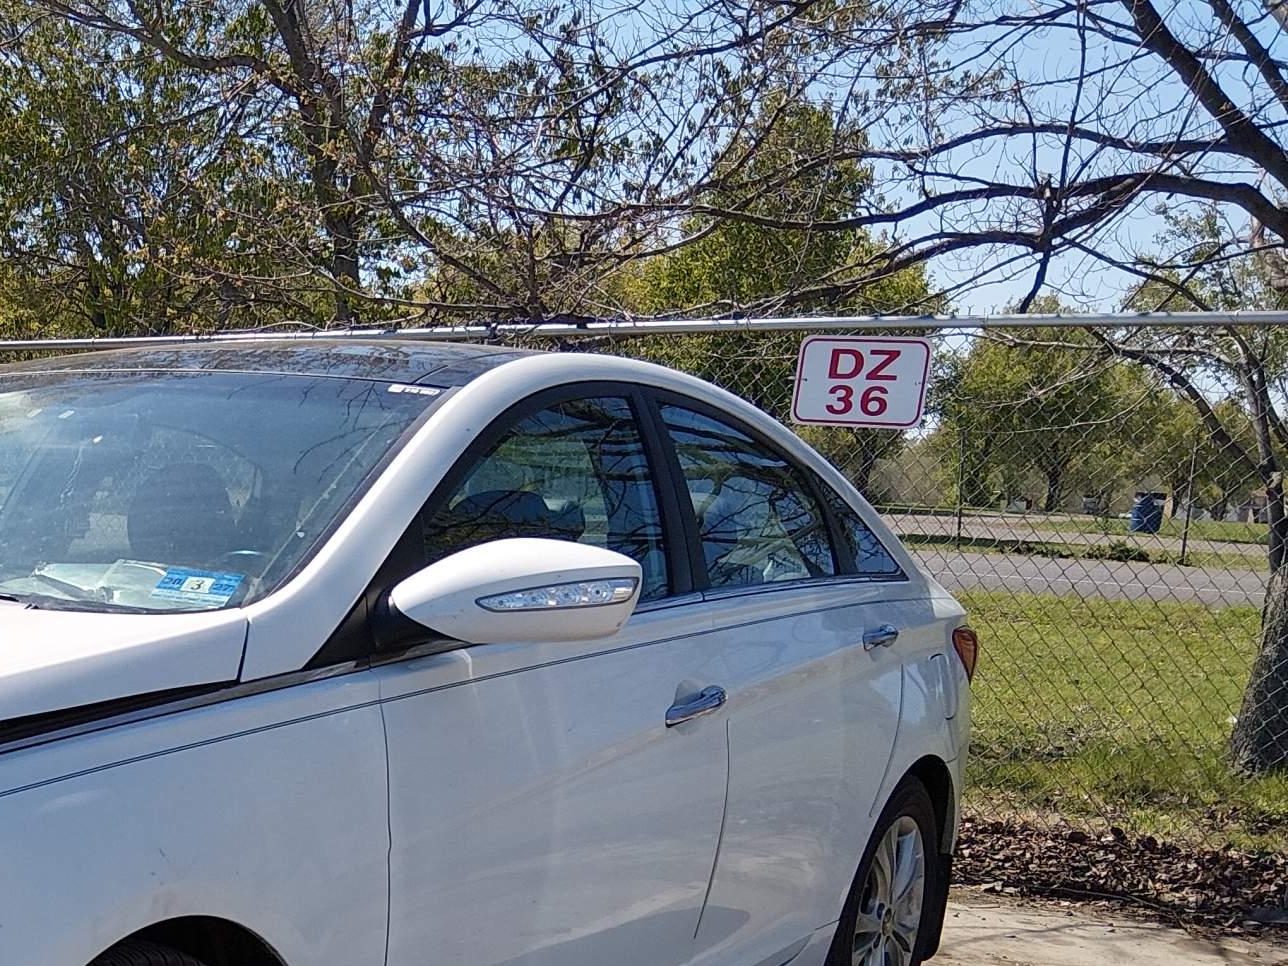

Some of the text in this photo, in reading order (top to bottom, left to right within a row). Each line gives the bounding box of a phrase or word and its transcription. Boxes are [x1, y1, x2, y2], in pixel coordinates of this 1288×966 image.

[828, 348, 902, 381] DZ
[825, 384, 889, 416] 36
[190, 579, 205, 591] 3
